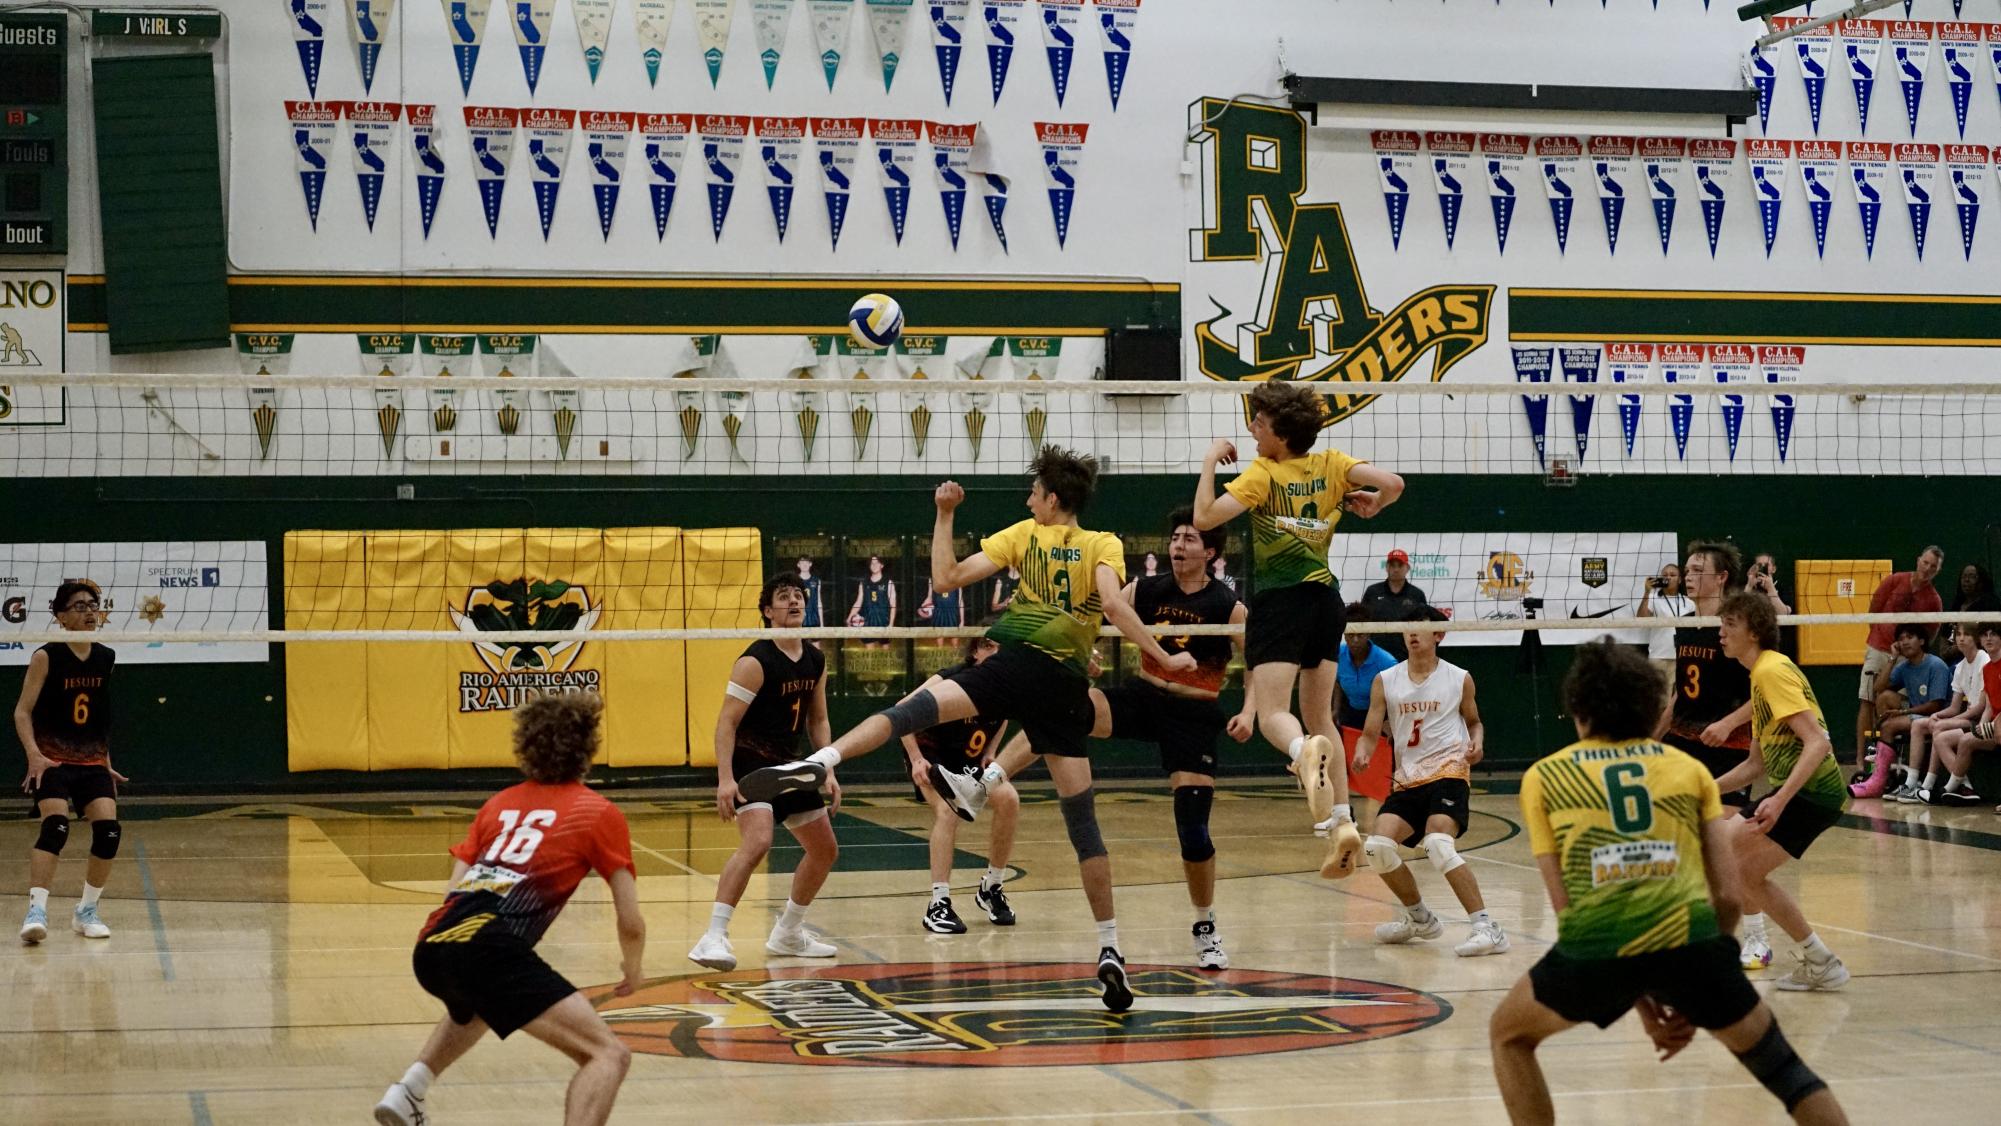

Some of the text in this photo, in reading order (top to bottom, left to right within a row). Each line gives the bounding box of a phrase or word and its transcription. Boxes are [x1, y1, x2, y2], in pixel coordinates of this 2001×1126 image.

[1845, 20, 1876, 30] C.A.L.
[1895, 21, 1925, 32] C.A.L.
[1944, 23, 1974, 33] C.A.L.
[1842, 30, 1879, 38] CHAMPIONS
[1892, 31, 1928, 39] CHAMPIONS
[1941, 32, 1976, 40] CHAMPIONS
[296, 102, 332, 112] C.A.L.
[354, 103, 390, 113] C.A.L.
[350, 113, 393, 121] CHAMPIONS
[474, 108, 509, 119] C.A.L.
[531, 110, 566, 121] C.A.L.
[590, 113, 626, 123] C.A.L.
[470, 119, 512, 127] CHAMPIONS
[526, 120, 568, 129] CHAMPIONS
[648, 115, 683, 125] C.A.L.
[706, 116, 740, 127] C.A.L.
[763, 119, 798, 129] C.A.L.
[821, 120, 856, 130] C.A.L.
[586, 123, 629, 131] CHAMPIONS
[644, 125, 686, 133] CHAMPIONS
[702, 126, 744, 135] CHAMPIONS
[879, 121, 913, 131] C.A.L.
[1045, 124, 1078, 135] C.A.L.
[759, 129, 801, 137] CHAMPIONS
[817, 130, 858, 138] CHAMPIONS
[874, 131, 916, 139] CHAMPIONS
[935, 126, 967, 138] C.A.L.
[931, 136, 970, 146] CHAMPIONS
[1041, 135, 1081, 143] CHAMPIONS
[1380, 132, 1412, 143] C.A.L.
[1434, 133, 1467, 144] C.A.L.
[1488, 135, 1521, 146] C.A.L.
[1542, 138, 1575, 147] C.A.L.
[1595, 137, 1627, 147] C.A.L.
[1376, 142, 1416, 150] CHAMPIONS
[1430, 143, 1469, 151] CHAMPIONS
[1645, 139, 1677, 148] C.A.L.
[1696, 140, 1728, 150] C.A.L.
[1751, 140, 1783, 150] C.A.L.
[1802, 142, 1833, 151] C.A.L.
[1853, 143, 1884, 154] C.A.L.
[1485, 145, 1523, 154] CHAMPIONS
[1540, 146, 1578, 155] CHAMPIONS
[1592, 146, 1630, 154] CHAMPIONS
[1643, 148, 1680, 156] CHAMPIONS
[1902, 145, 1932, 154] C.A.L.
[1952, 145, 1981, 155] C.A.L.
[1949, 155, 1984, 163] CHAMPIONS
[6, 223, 44, 244] bout
[248, 336, 282, 346] C.V.C.
[370, 336, 404, 346] C.V.C.
[431, 338, 464, 347] C.V.C.
[490, 336, 523, 346] C.V.C.
[904, 339, 936, 348] C.V.C.
[1019, 340, 1050, 348] C.V.C.
[1612, 345, 1644, 354] C.A.L.
[1664, 346, 1696, 355] C.A.L.
[1715, 346, 1747, 356] C.A.L.
[1765, 347, 1796, 357] C.A.L.
[1408, 552, 1448, 564] Sutter
[148, 567, 199, 576] SPECTRUM
[1410, 566, 1449, 577] Health
[1525, 571, 1534, 580] 24
[160, 577, 199, 587] NEWS
[104, 599, 114, 609] 24
[2, 596, 26, 623] G
[1679, 646, 1716, 660] JESUIT
[64, 677, 102, 689] JESUIT
[461, 670, 599, 687] RIO AMERICANO
[1684, 664, 1700, 698] 3
[781, 679, 815, 698] JESUIT
[74, 693, 89, 724] 6
[1398, 701, 1441, 714] JESUIT
[965, 730, 986, 758] 9
[1572, 744, 1664, 764] THALKEN
[1603, 761, 1653, 834] 6
[484, 809, 557, 865] 16
